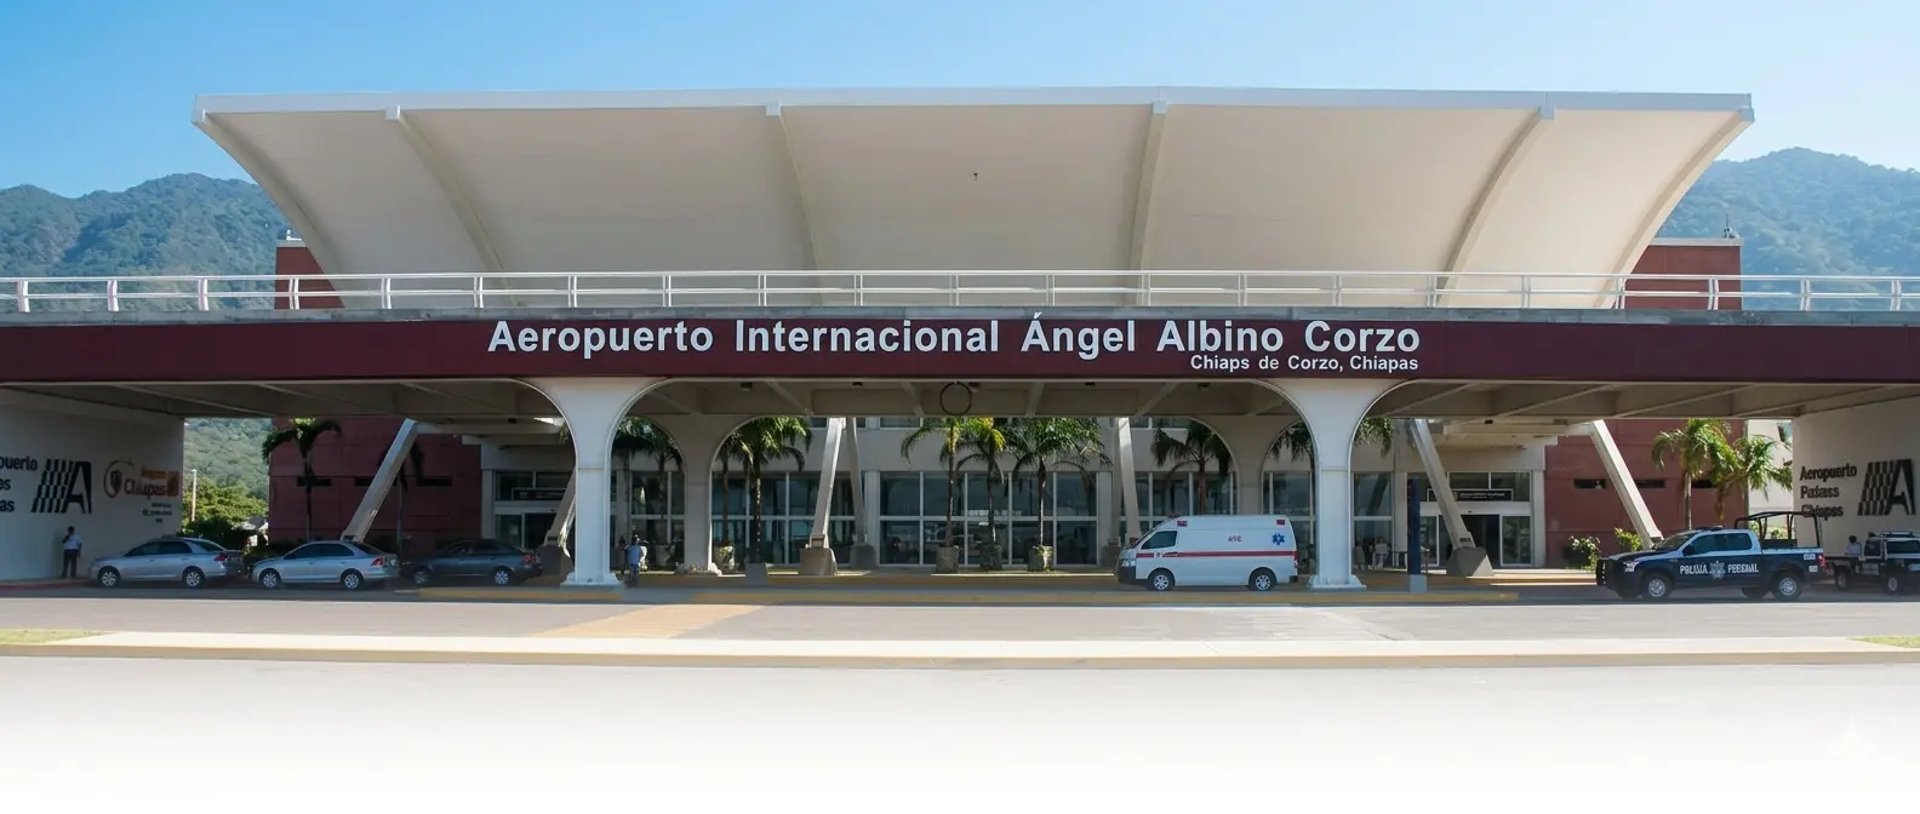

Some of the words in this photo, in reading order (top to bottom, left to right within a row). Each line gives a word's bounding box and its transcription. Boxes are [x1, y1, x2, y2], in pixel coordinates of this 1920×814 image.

[488, 320, 713, 359] Aeropuerto
[737, 320, 998, 351] Internacional
[1021, 312, 1135, 360] Ángel
[1157, 320, 1284, 352] Albino
[1305, 320, 1420, 352] Corzo
[1190, 355, 1250, 373] Chiaps
[1258, 355, 1280, 370] de
[1287, 355, 1344, 373] Corzo,
[1350, 355, 1419, 373] Chiapas
[1800, 463, 1857, 482] Aeropuerto
